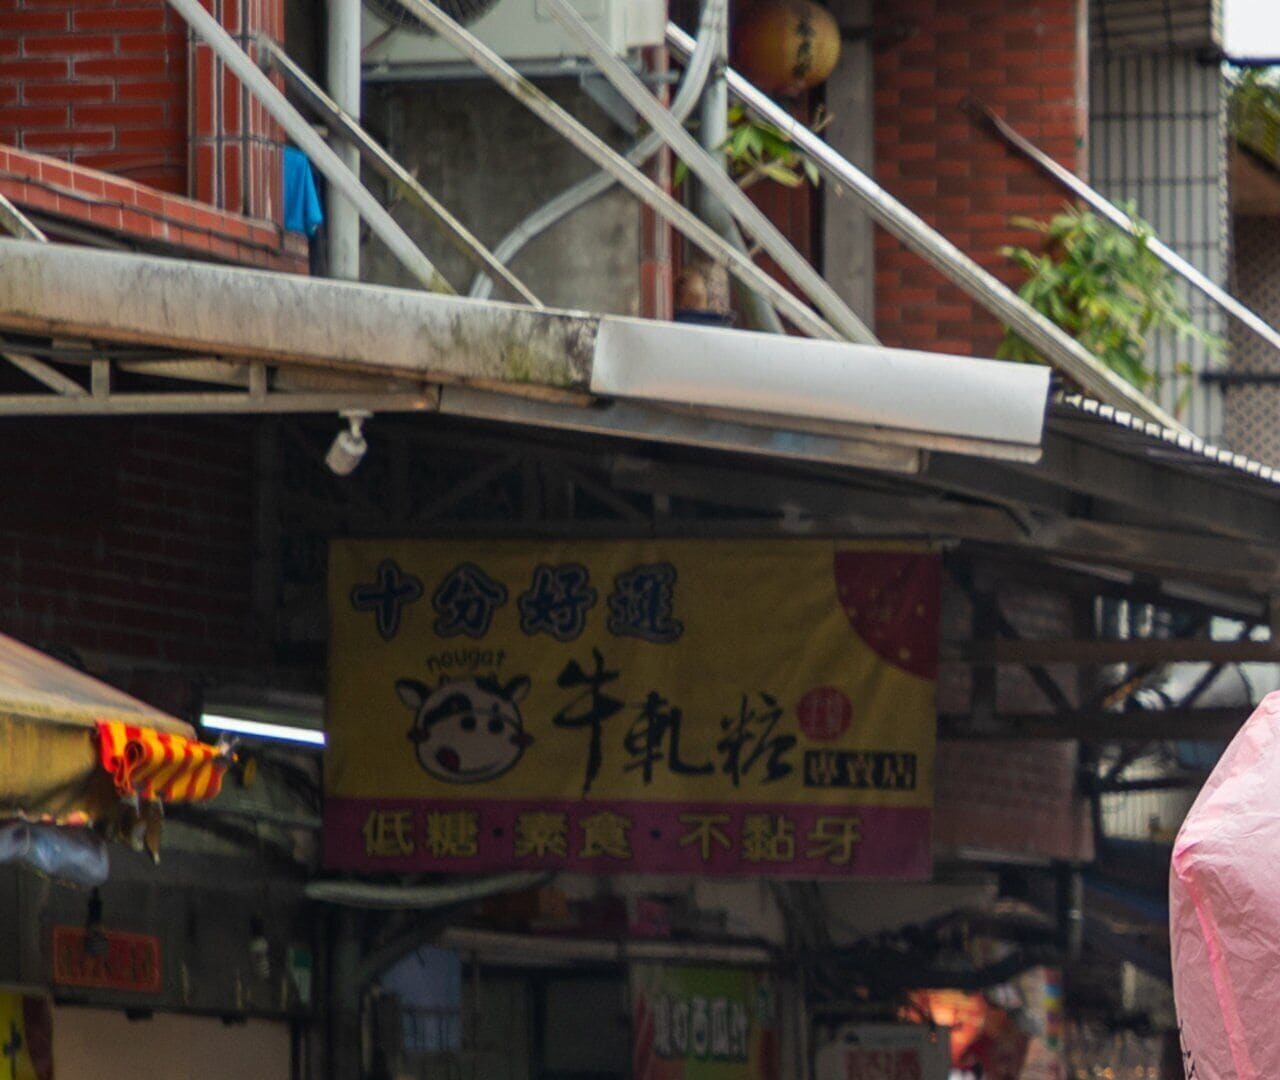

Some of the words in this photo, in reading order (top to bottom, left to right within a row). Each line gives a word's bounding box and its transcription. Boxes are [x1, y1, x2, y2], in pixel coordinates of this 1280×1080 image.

[351, 558, 685, 644] 十分好運
[552, 647, 799, 798] 牛軋糖
